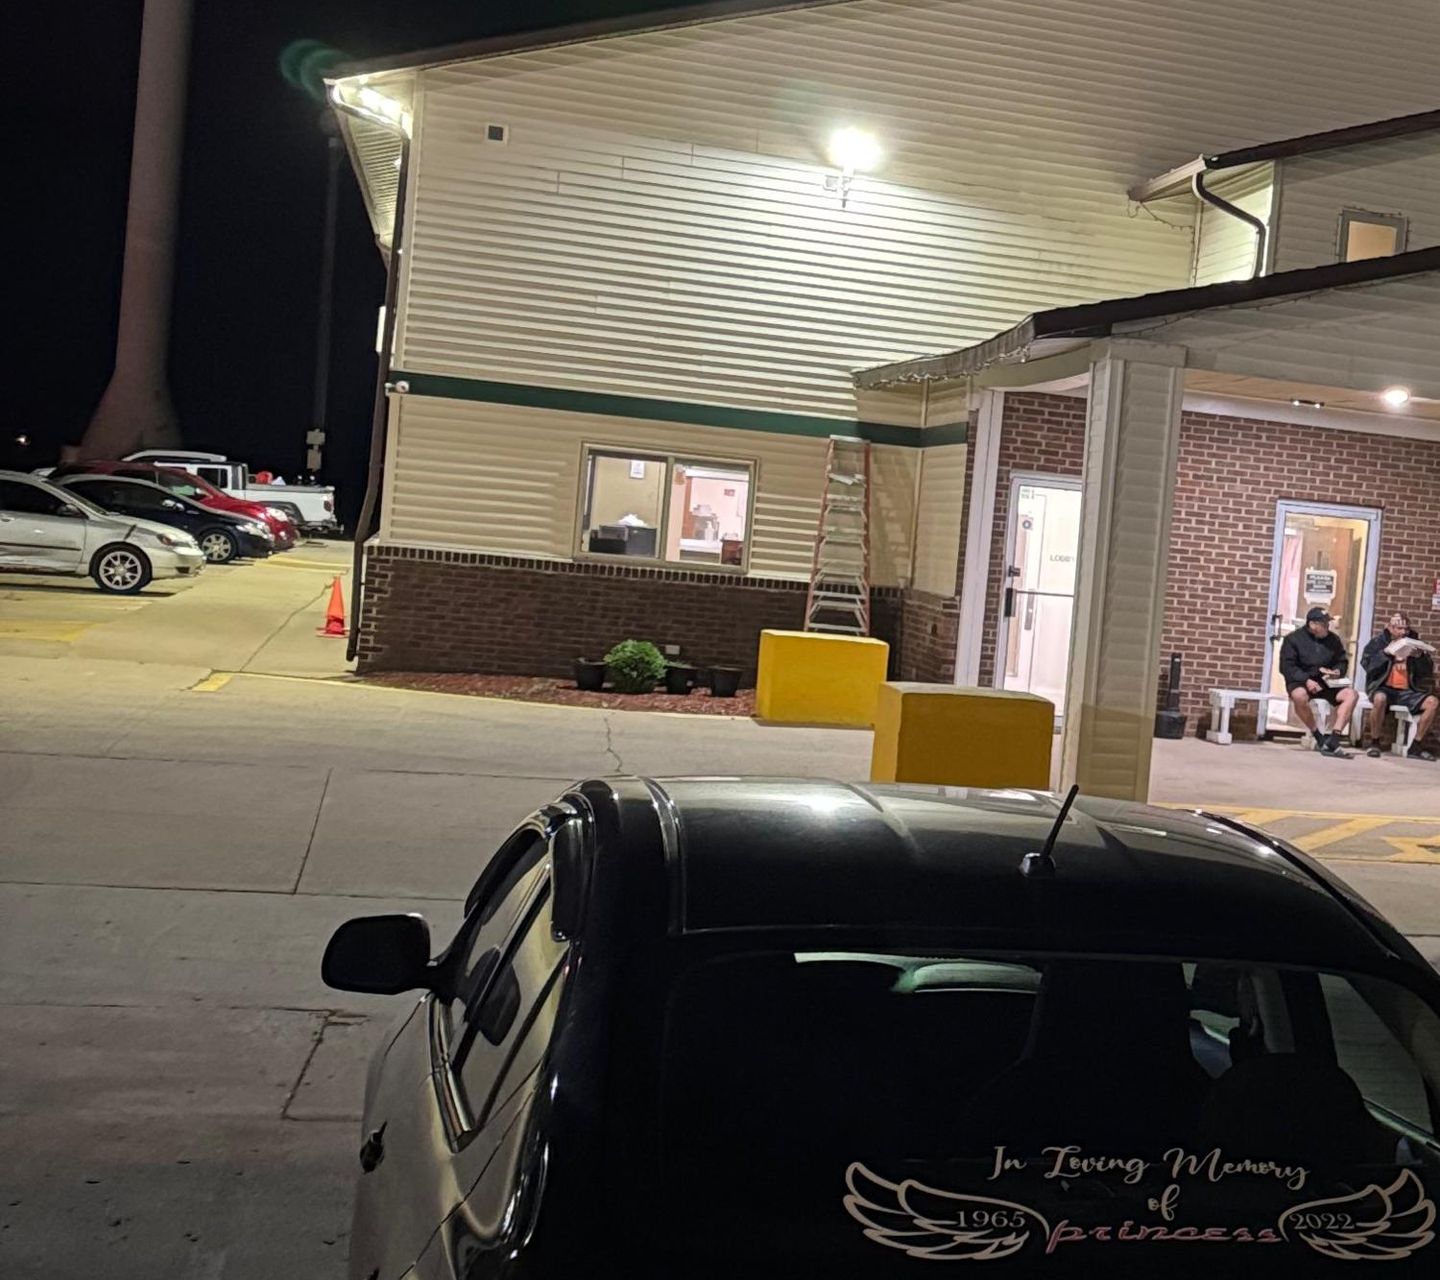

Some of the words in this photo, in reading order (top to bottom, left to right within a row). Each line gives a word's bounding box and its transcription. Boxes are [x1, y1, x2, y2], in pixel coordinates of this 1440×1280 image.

[1041, 1145, 1149, 1184] Loving
[1163, 1147, 1311, 1190] Memory
[956, 1210, 1026, 1229] 1965
[1147, 1184, 1179, 1221] of
[1045, 1220, 1282, 1254] princess
[1288, 1213, 1356, 1231] 2022
